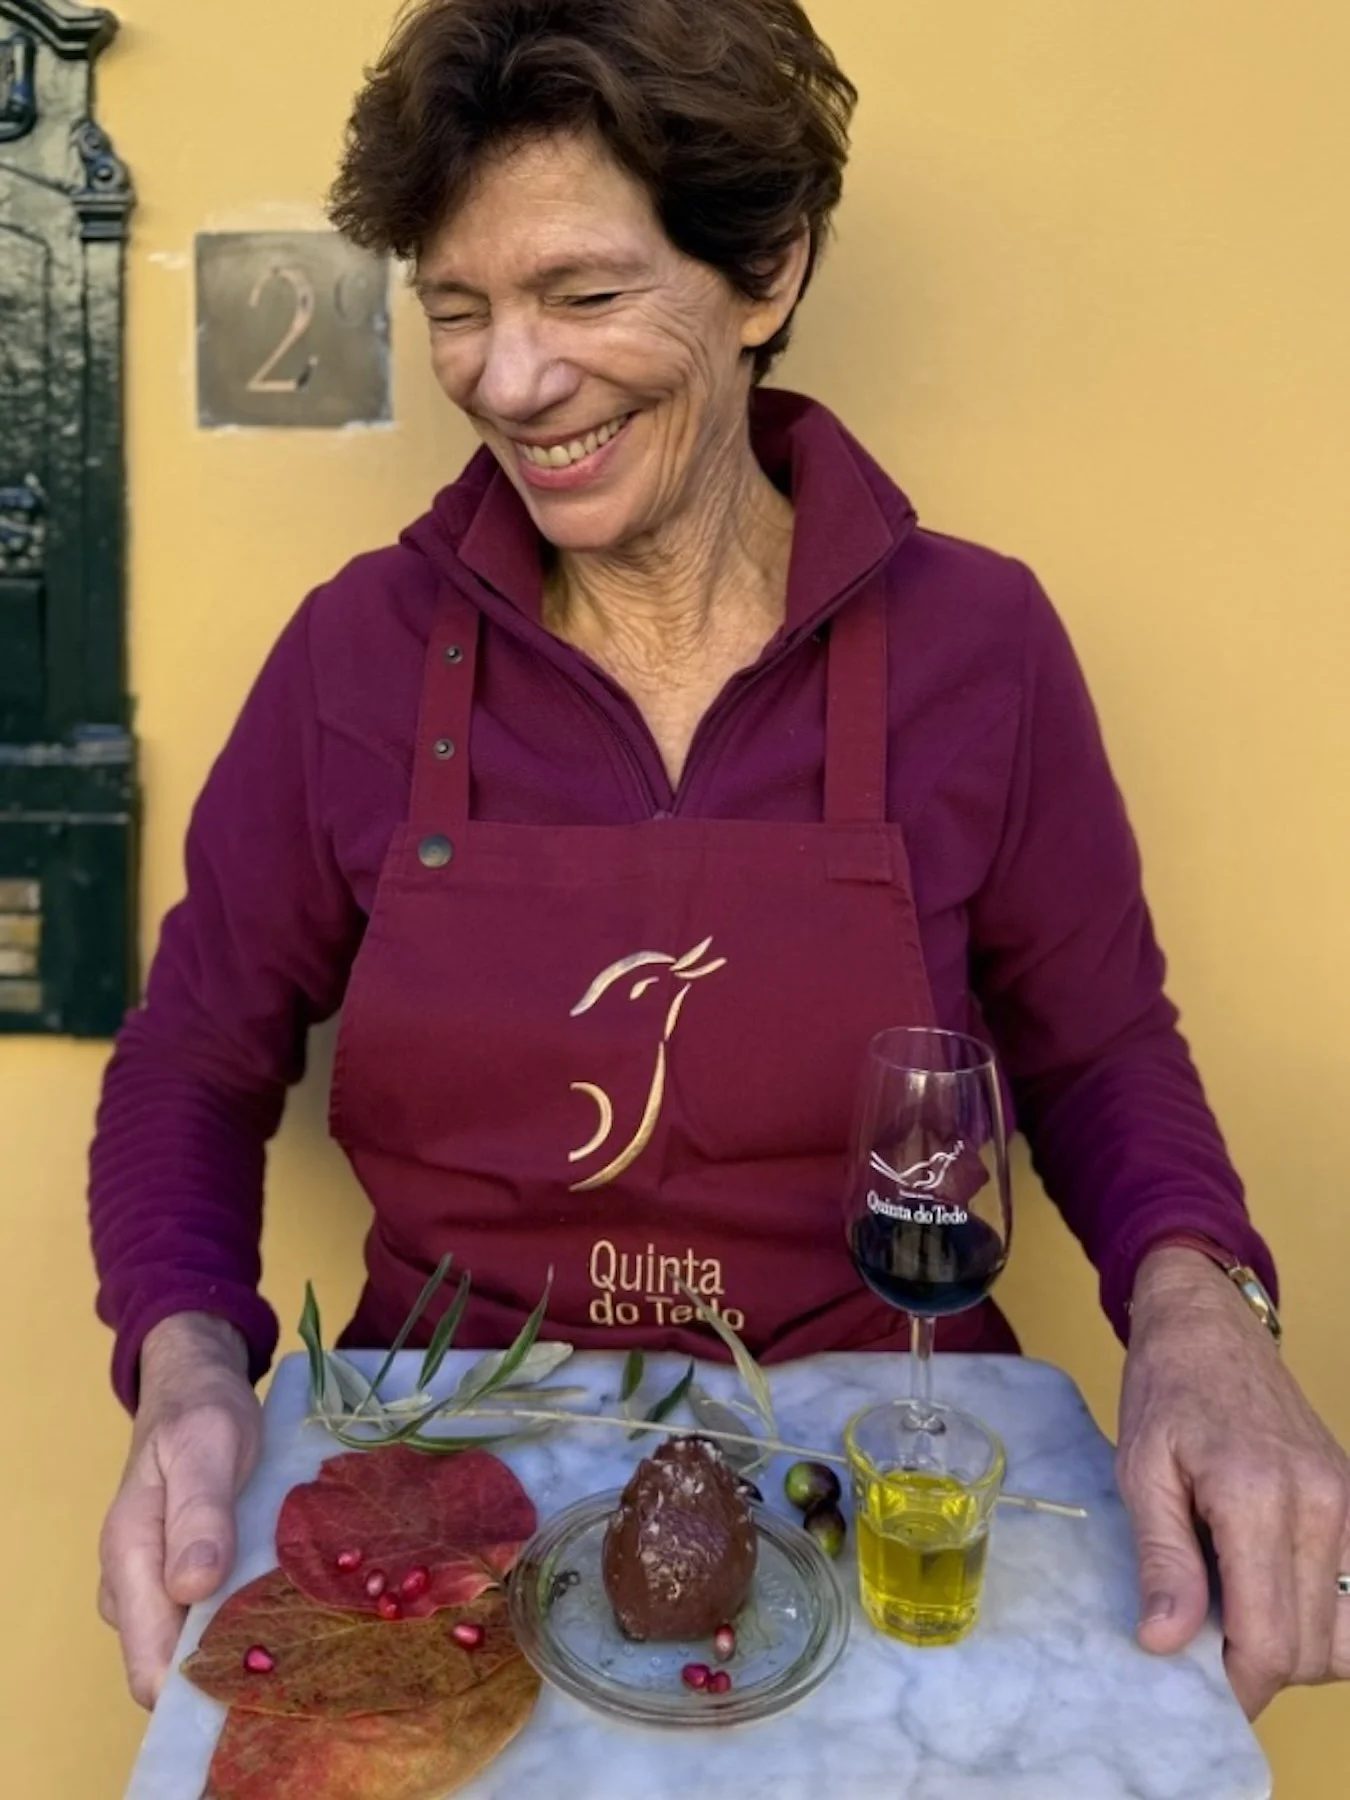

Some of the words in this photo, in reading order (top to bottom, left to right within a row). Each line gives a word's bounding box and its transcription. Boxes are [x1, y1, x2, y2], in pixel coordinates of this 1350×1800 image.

[867, 1190, 912, 1222] Quinta
[913, 1204, 932, 1224] do
[933, 1205, 968, 1225] Tedo
[590, 1239, 725, 1295] Quinta
[589, 1292, 640, 1326] do
